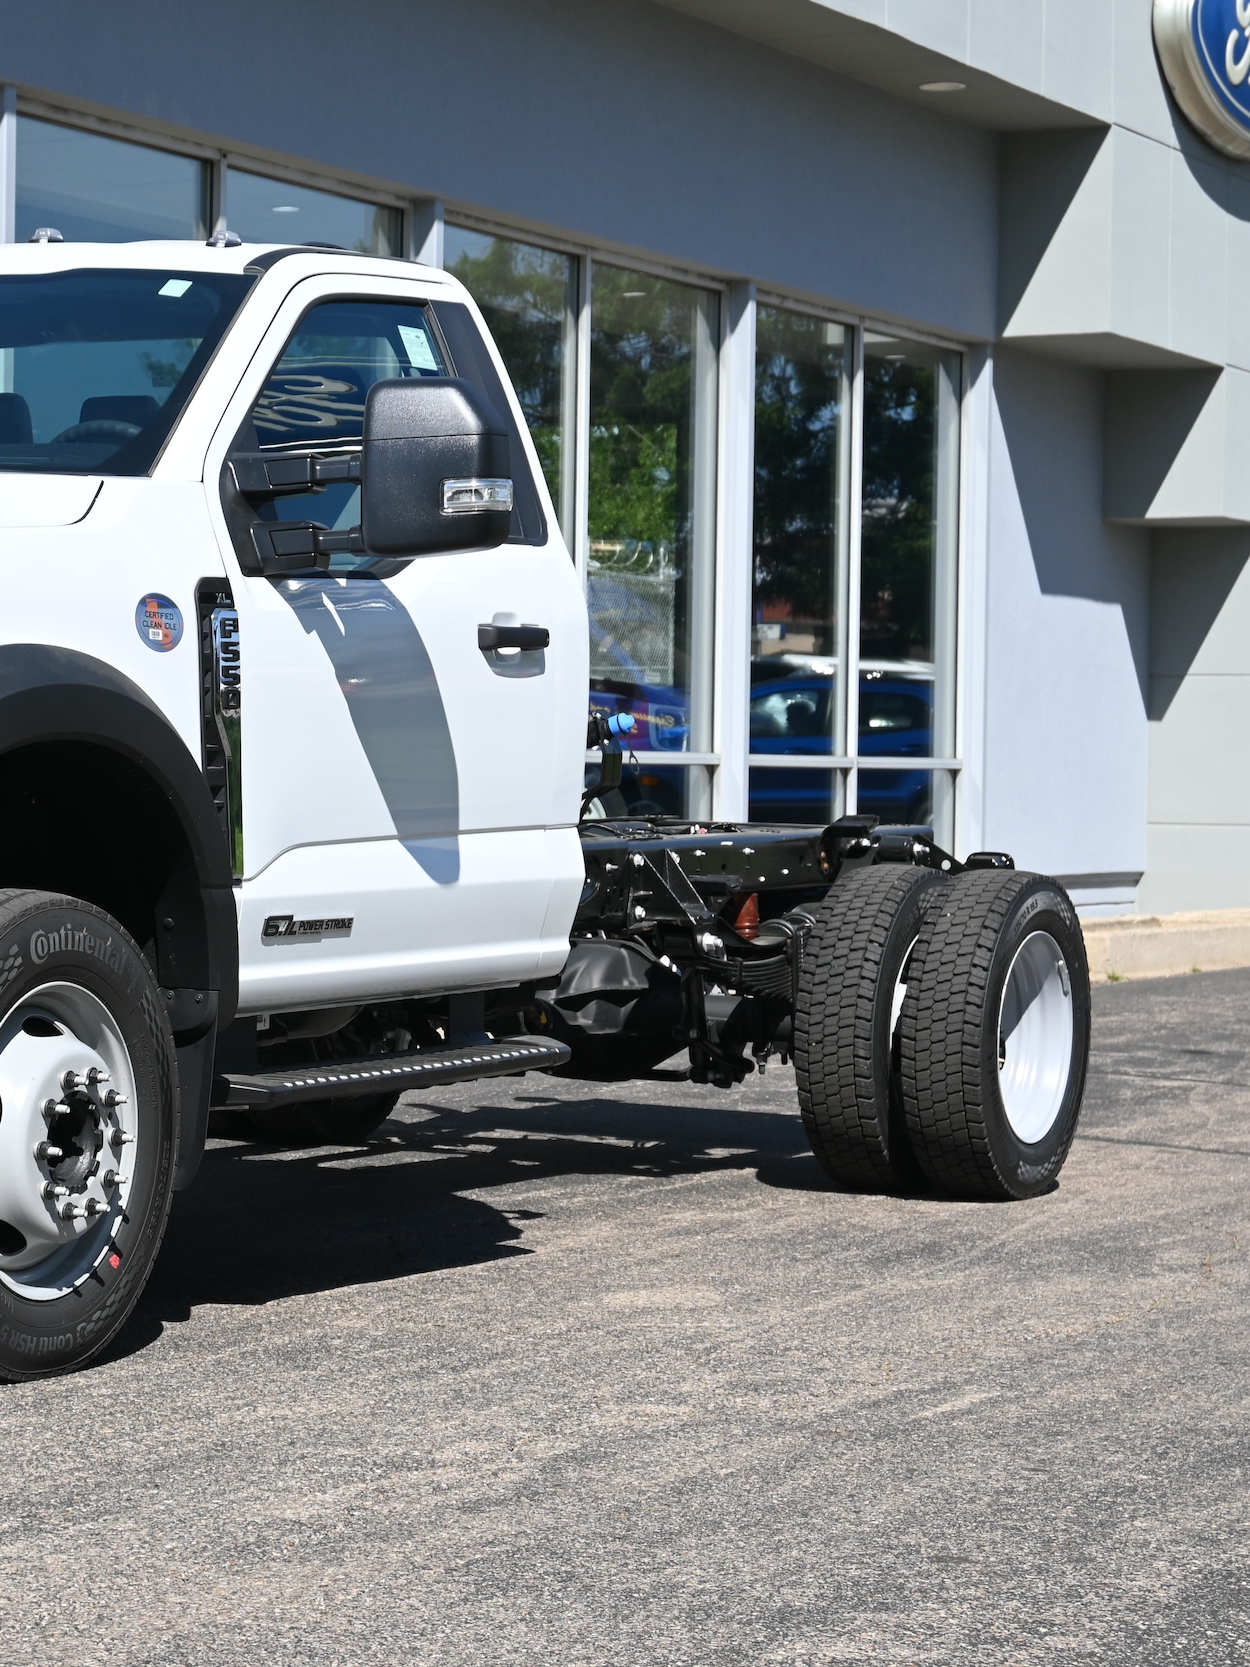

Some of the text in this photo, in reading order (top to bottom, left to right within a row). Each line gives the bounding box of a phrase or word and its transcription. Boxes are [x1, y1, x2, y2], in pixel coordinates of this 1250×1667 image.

[215, 593, 231, 604] XL
[144, 610, 174, 621] CERTIFIED
[142, 619, 178, 631] CLEAN IDLE
[298, 920, 324, 931] POWER
[324, 918, 353, 930] STROKE
[29, 923, 127, 977] Continental
[8, 1329, 37, 1354] HSR
[37, 1333, 73, 1356] Conti
